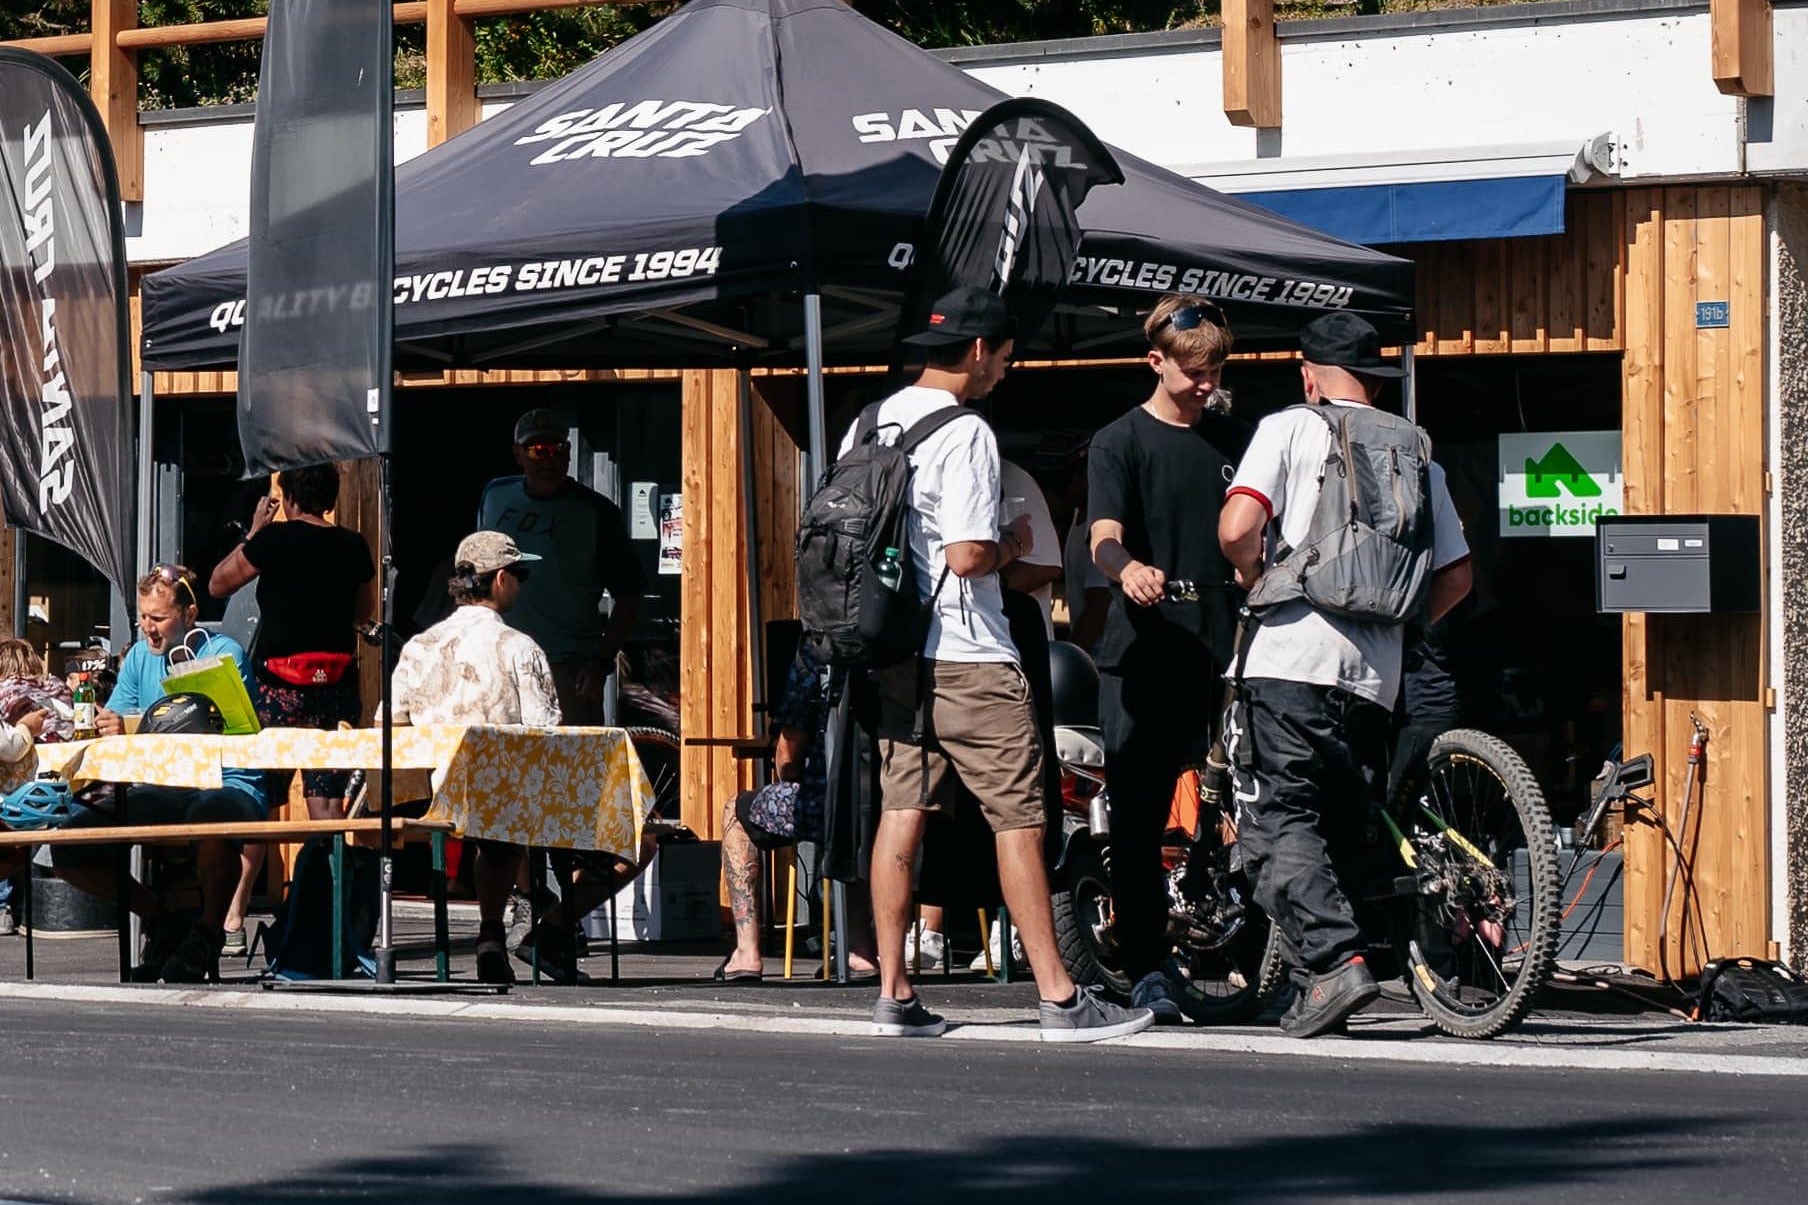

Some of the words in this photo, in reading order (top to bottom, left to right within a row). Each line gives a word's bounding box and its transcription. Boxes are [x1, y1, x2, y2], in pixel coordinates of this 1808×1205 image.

[513, 100, 766, 145] SANTA
[530, 130, 742, 165] CRUZ
[349, 265, 513, 310] BCYCLES
[515, 254, 626, 292] SINCE
[627, 246, 724, 282] 1994
[1069, 257, 1177, 291] CYCLES
[1178, 267, 1275, 303] SINCE
[1274, 279, 1354, 309] 1994
